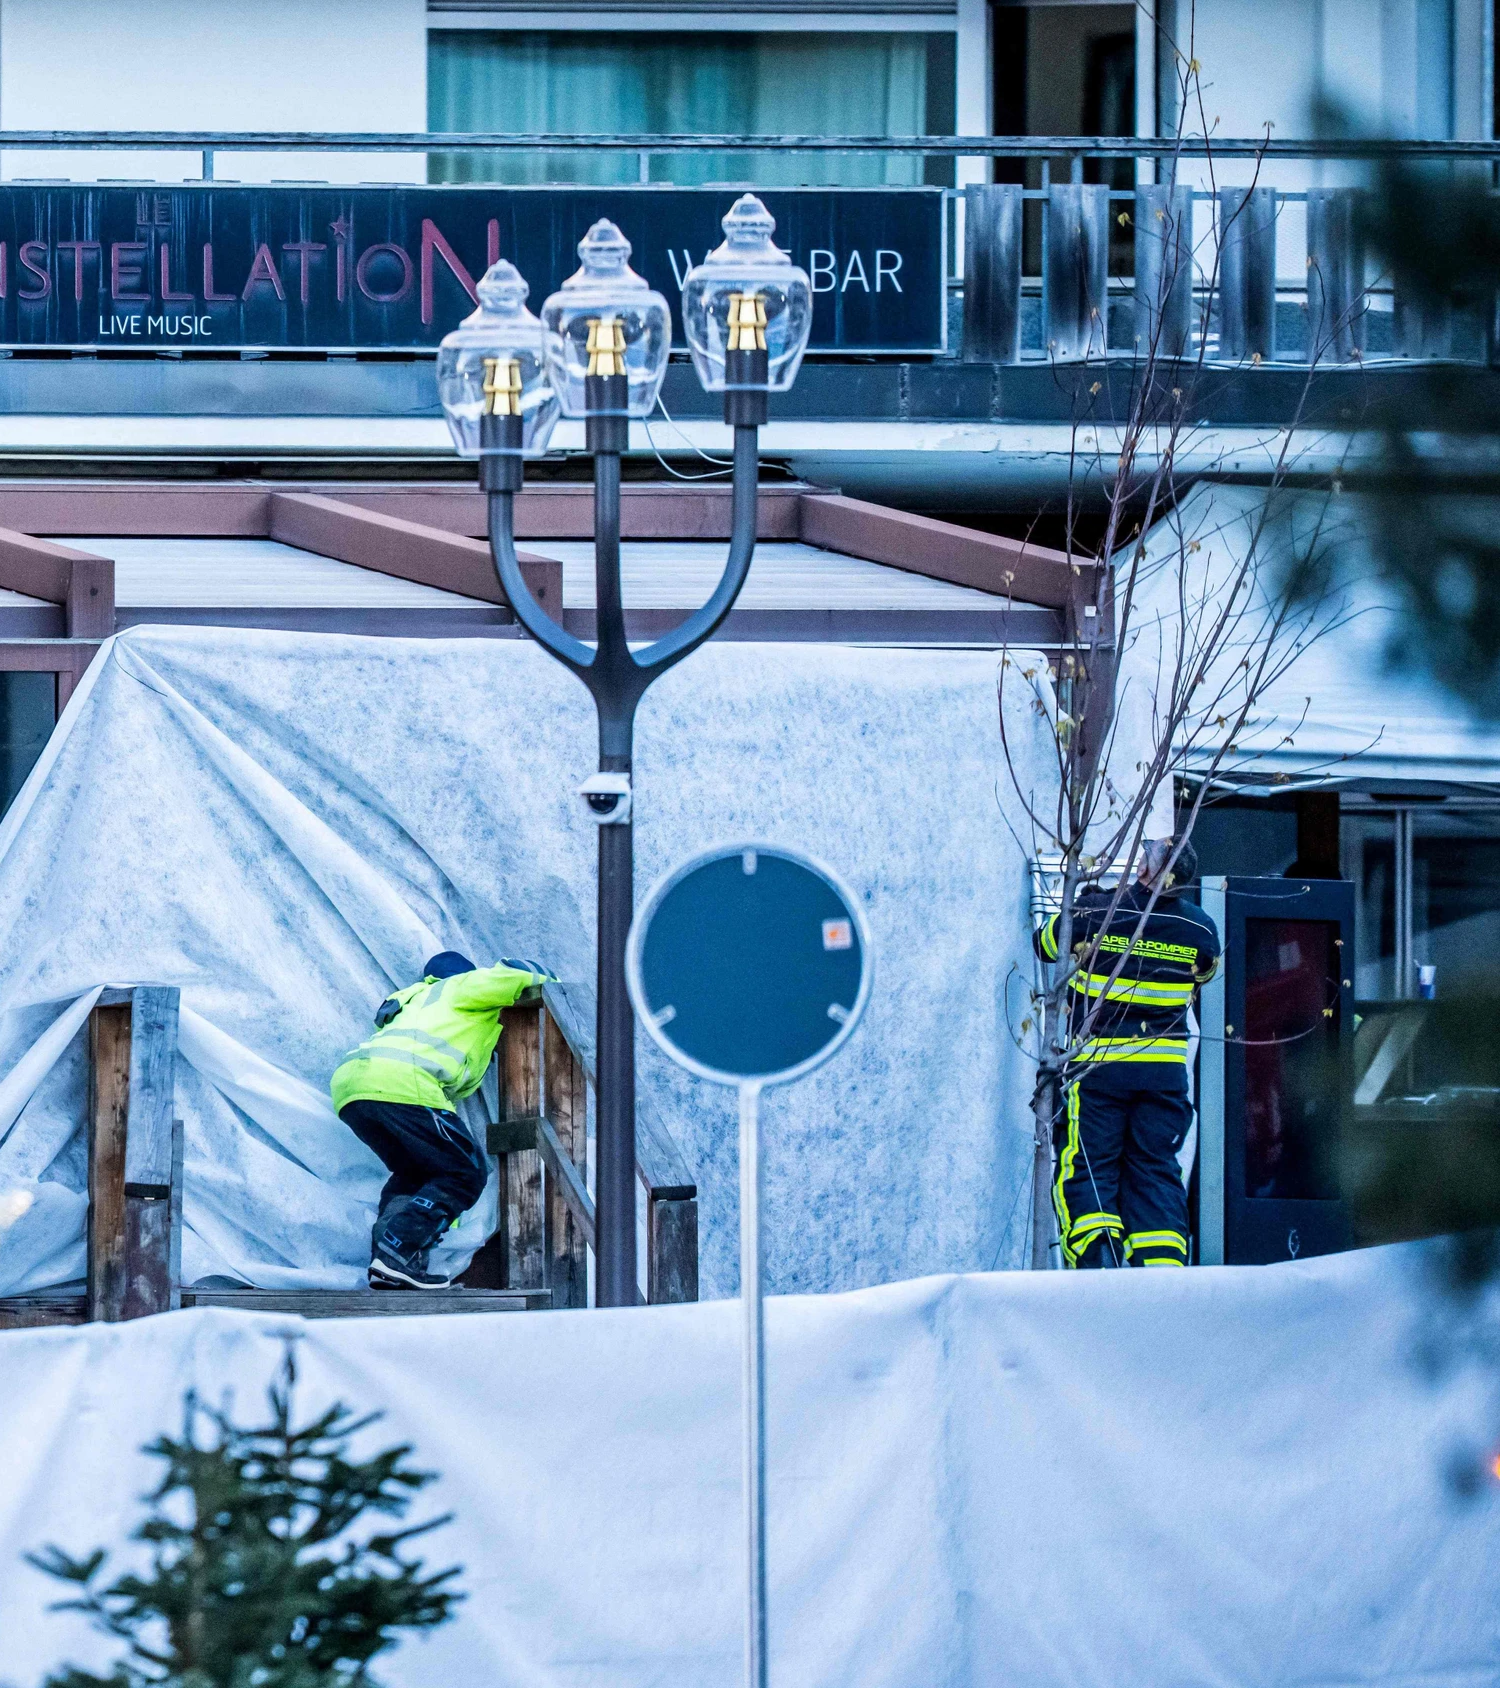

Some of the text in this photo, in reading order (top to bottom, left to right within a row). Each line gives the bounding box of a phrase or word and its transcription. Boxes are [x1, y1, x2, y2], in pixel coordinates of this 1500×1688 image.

[137, 193, 171, 225] LE
[810, 249, 903, 293] BAR
[99, 315, 212, 335] LIVE MUSIC
